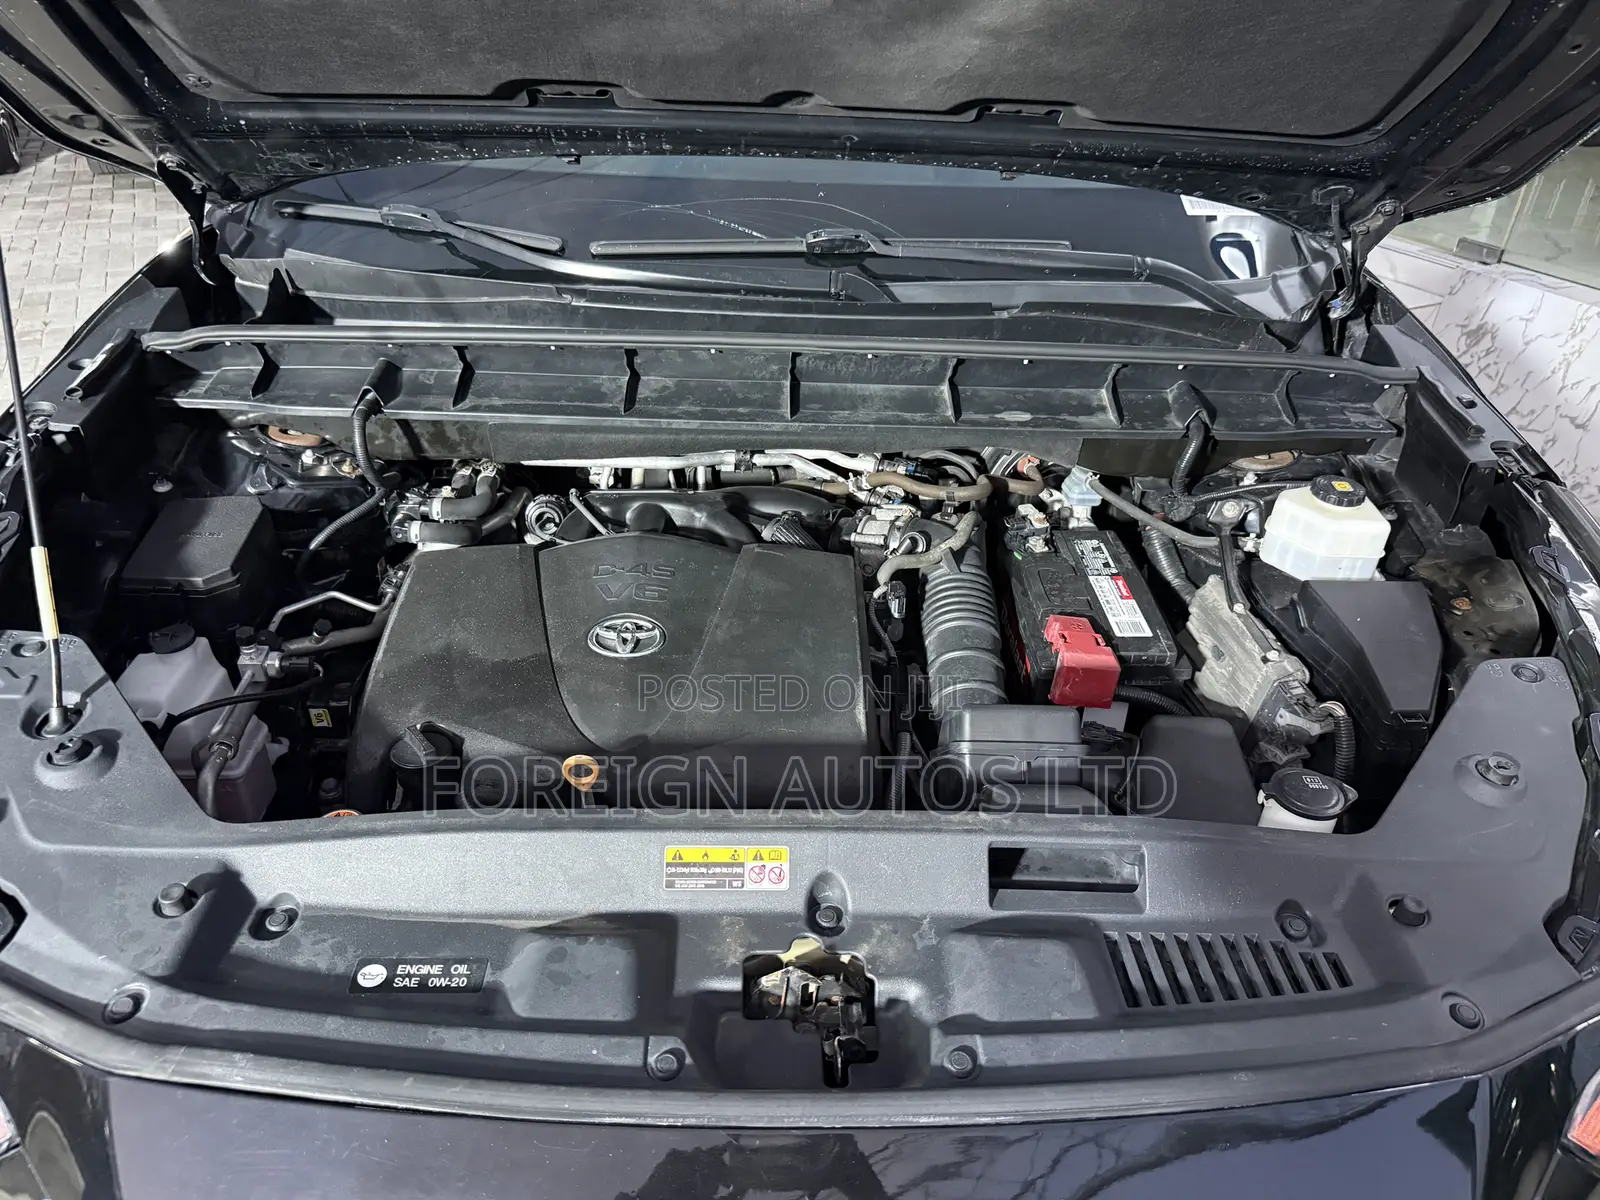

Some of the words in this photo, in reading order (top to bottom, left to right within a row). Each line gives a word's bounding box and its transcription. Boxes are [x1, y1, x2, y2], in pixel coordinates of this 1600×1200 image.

[593, 563, 676, 579] D-4S
[596, 582, 669, 602] V6
[396, 964, 444, 975] ENGINE
[450, 964, 471, 975] OIL
[393, 977, 420, 987] SAE
[428, 977, 467, 987] 0W-20
